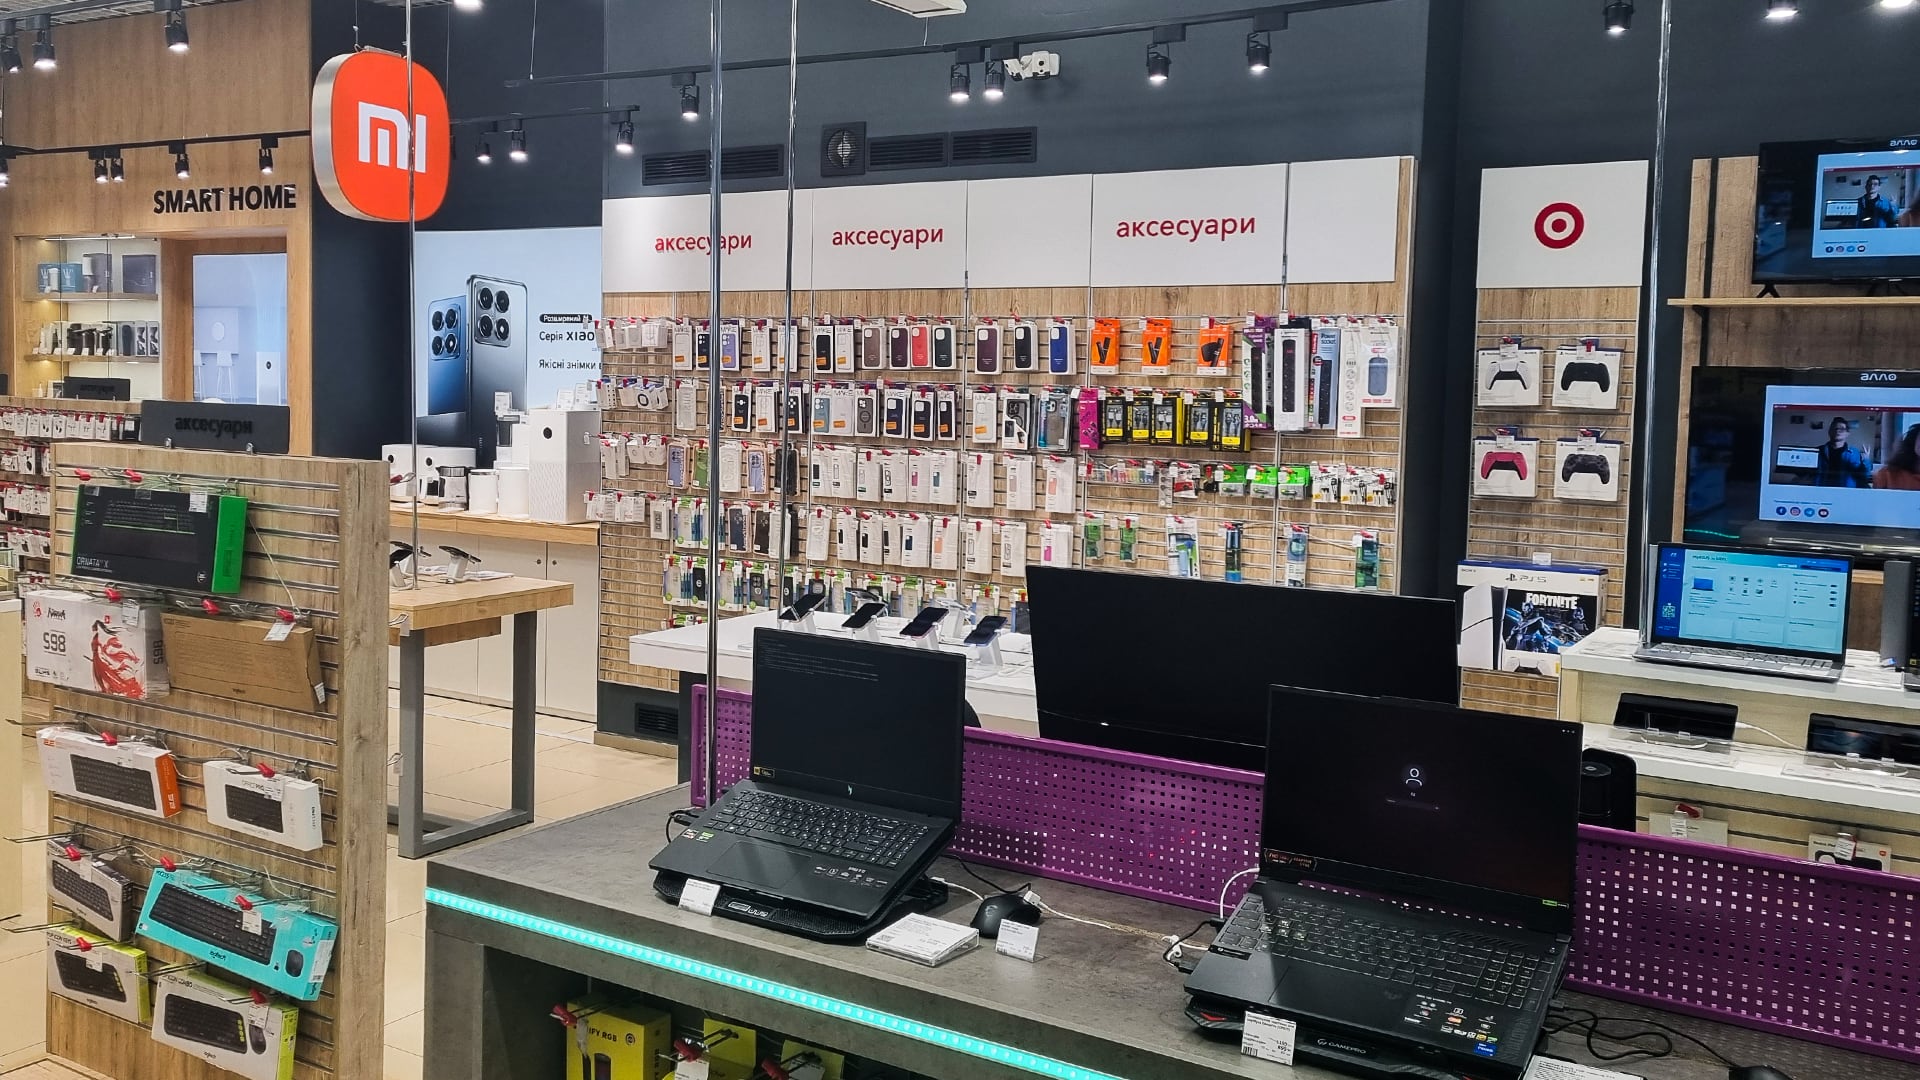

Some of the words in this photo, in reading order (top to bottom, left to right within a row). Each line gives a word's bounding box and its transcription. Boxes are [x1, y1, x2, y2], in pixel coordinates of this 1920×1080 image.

[153, 187, 225, 214] SMART
[229, 184, 296, 211] HOME
[832, 226, 944, 250] аксесуари
[1116, 217, 1256, 242] аксесуари
[174, 416, 253, 438] аксесуари
[1525, 592, 1578, 609] FORTNITE
[43, 632, 66, 652] S98
[602, 1031, 618, 1042] RGB
